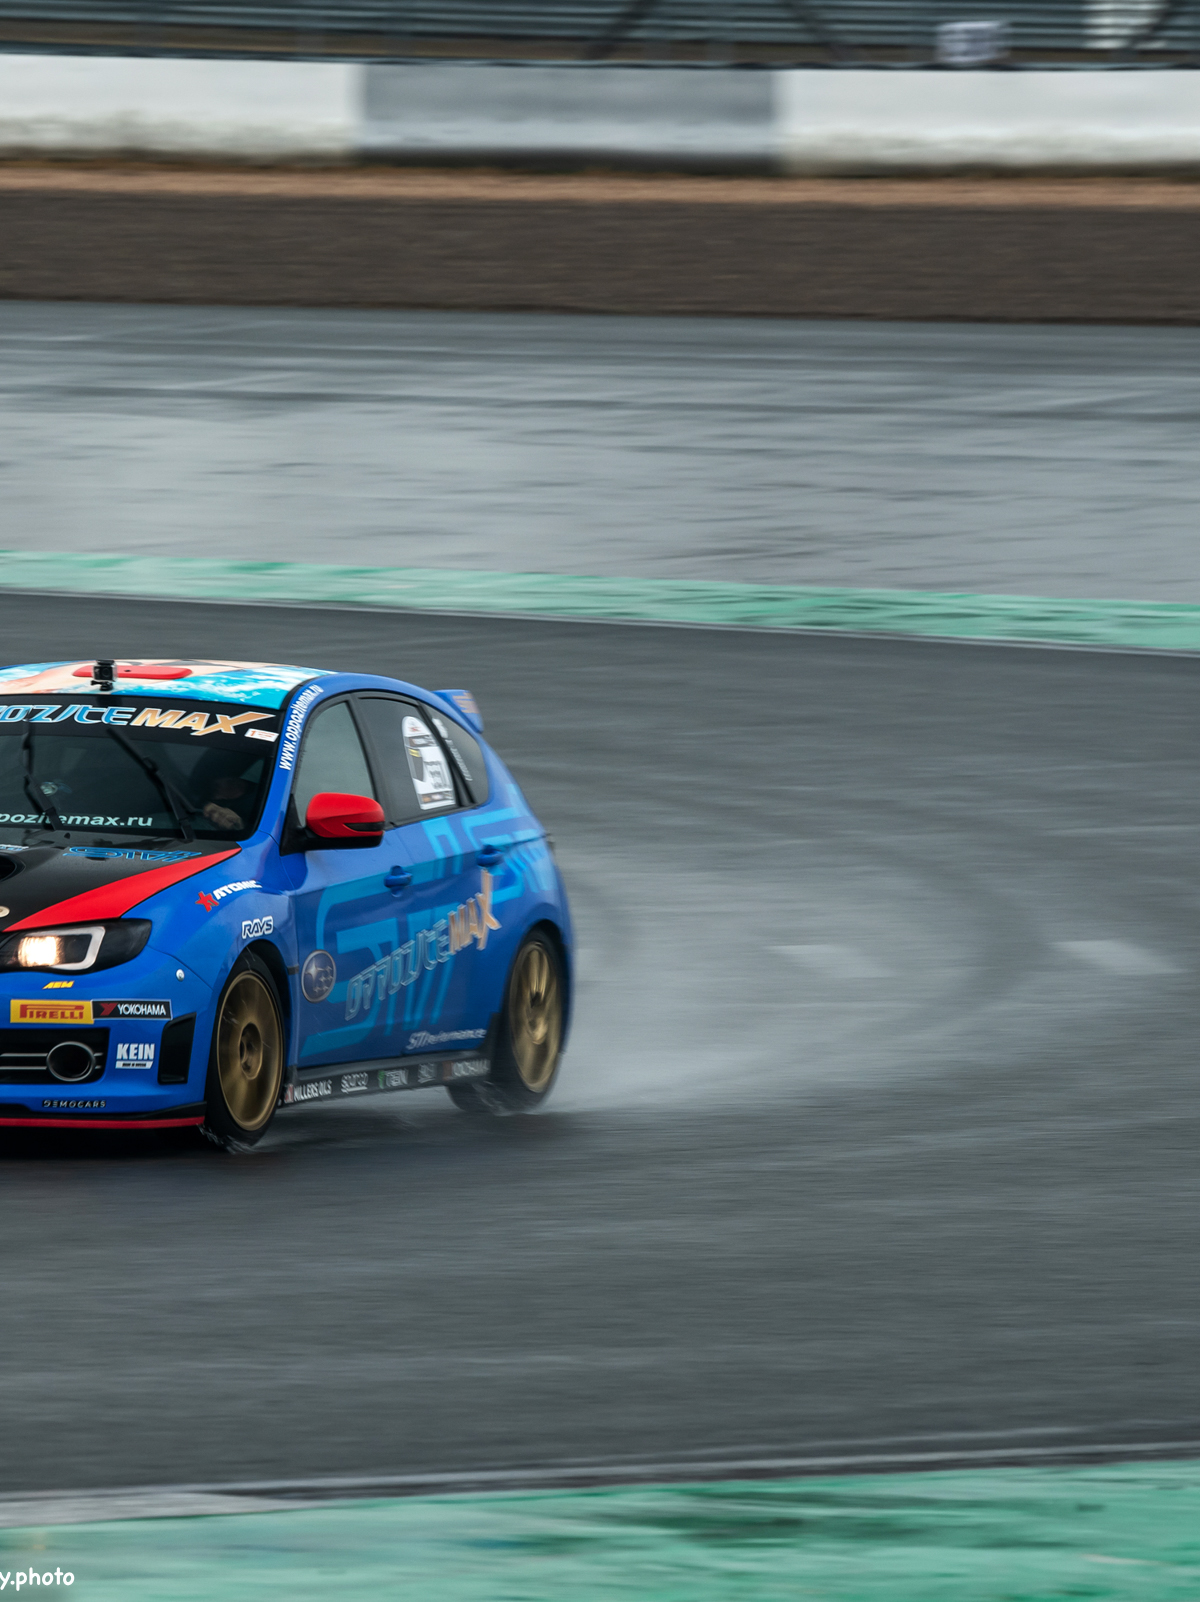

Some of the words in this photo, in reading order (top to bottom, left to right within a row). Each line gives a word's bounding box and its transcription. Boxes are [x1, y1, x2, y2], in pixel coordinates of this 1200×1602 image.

[213, 880, 262, 900] ATOMIC
[242, 916, 273, 939] RAYS
[19, 1004, 85, 1019] PIRELLI
[117, 1003, 167, 1016] YOKOHAMA
[116, 1043, 155, 1060] KEIN
